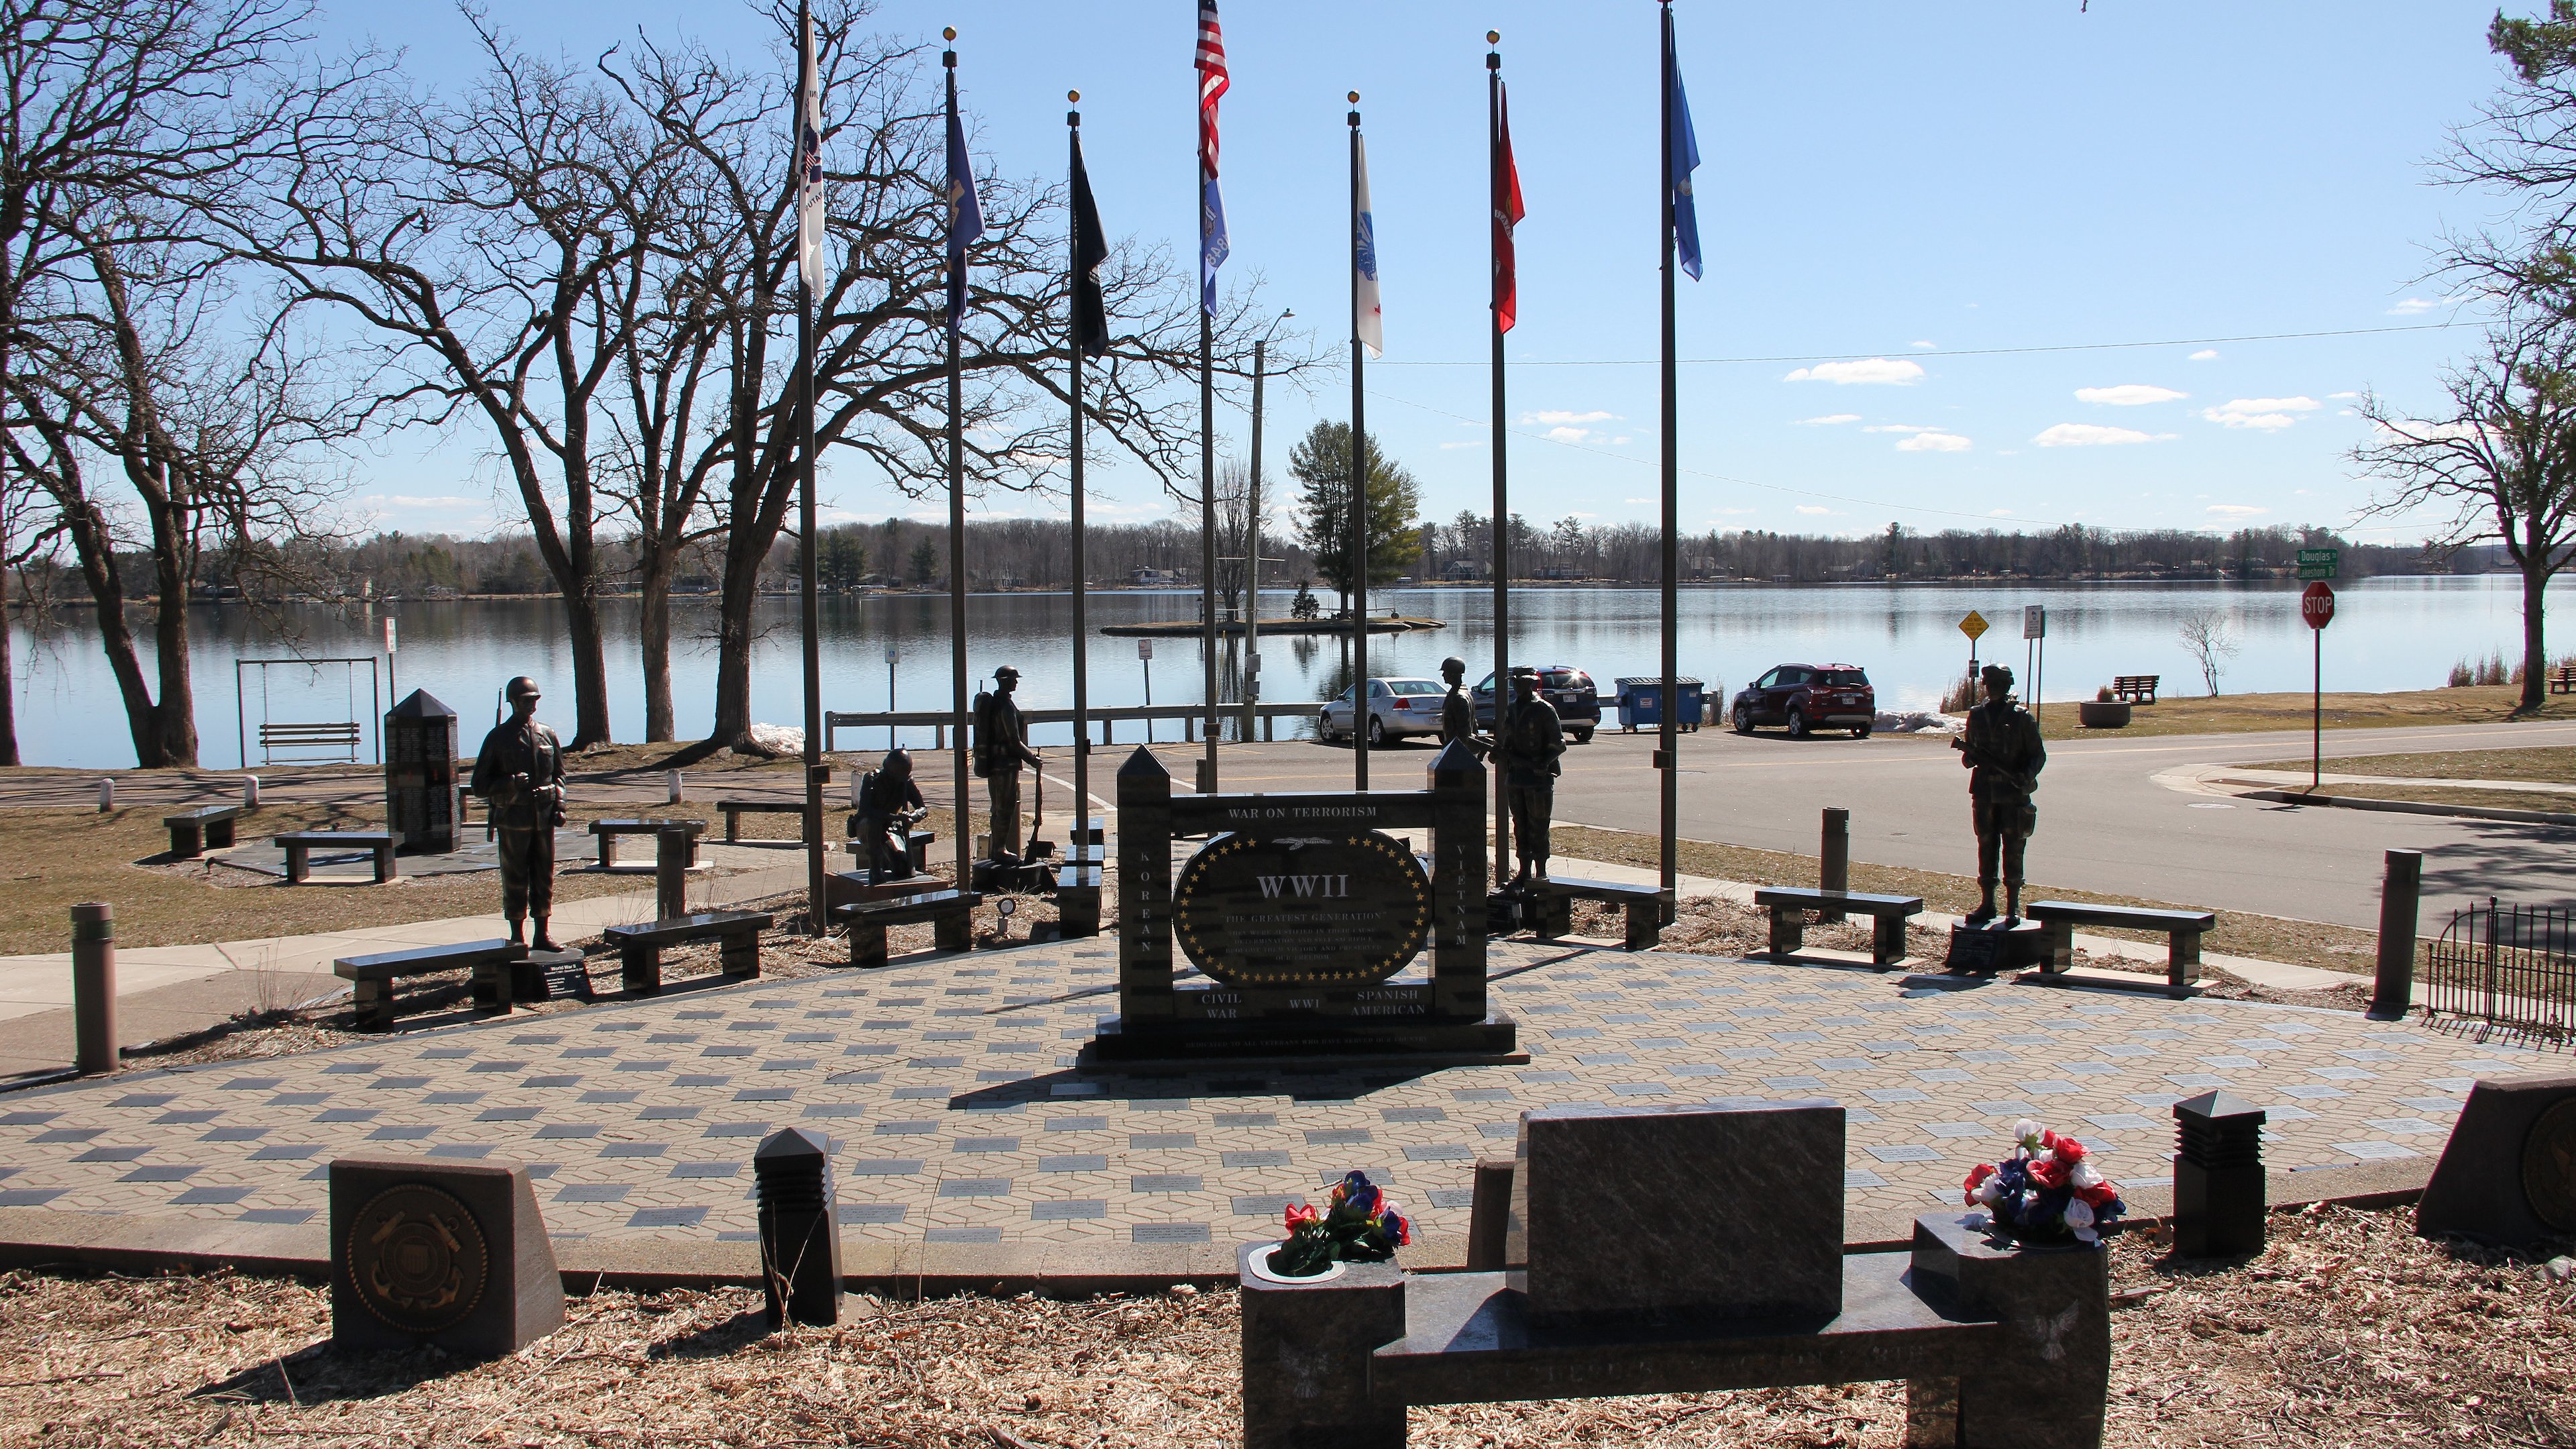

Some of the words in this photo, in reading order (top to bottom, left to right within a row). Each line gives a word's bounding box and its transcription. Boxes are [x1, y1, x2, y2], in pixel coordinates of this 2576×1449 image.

[2302, 551, 2330, 563] Douglas
[2298, 568, 2326, 578] Lakeshore
[2329, 566, 2335, 576] Dr
[2304, 596, 2332, 614] STOP
[1228, 808, 1259, 819] WAR
[1266, 807, 1286, 818] ON
[1292, 806, 1377, 818] TERRORISM
[1256, 874, 1349, 899] WWII
[1456, 845, 1466, 945] VIETNAM
[1140, 852, 1150, 952] KOREAN
[1251, 912, 1307, 923] GREATEST
[1234, 937, 1295, 945] DETERMINATION
[1201, 994, 1242, 1004] CIVIL
[1357, 989, 1418, 1000] SPANISH
[1289, 999, 1321, 1009] WWI
[1351, 1004, 1426, 1016] AMERICAN
[1207, 1009, 1238, 1019] WAR
